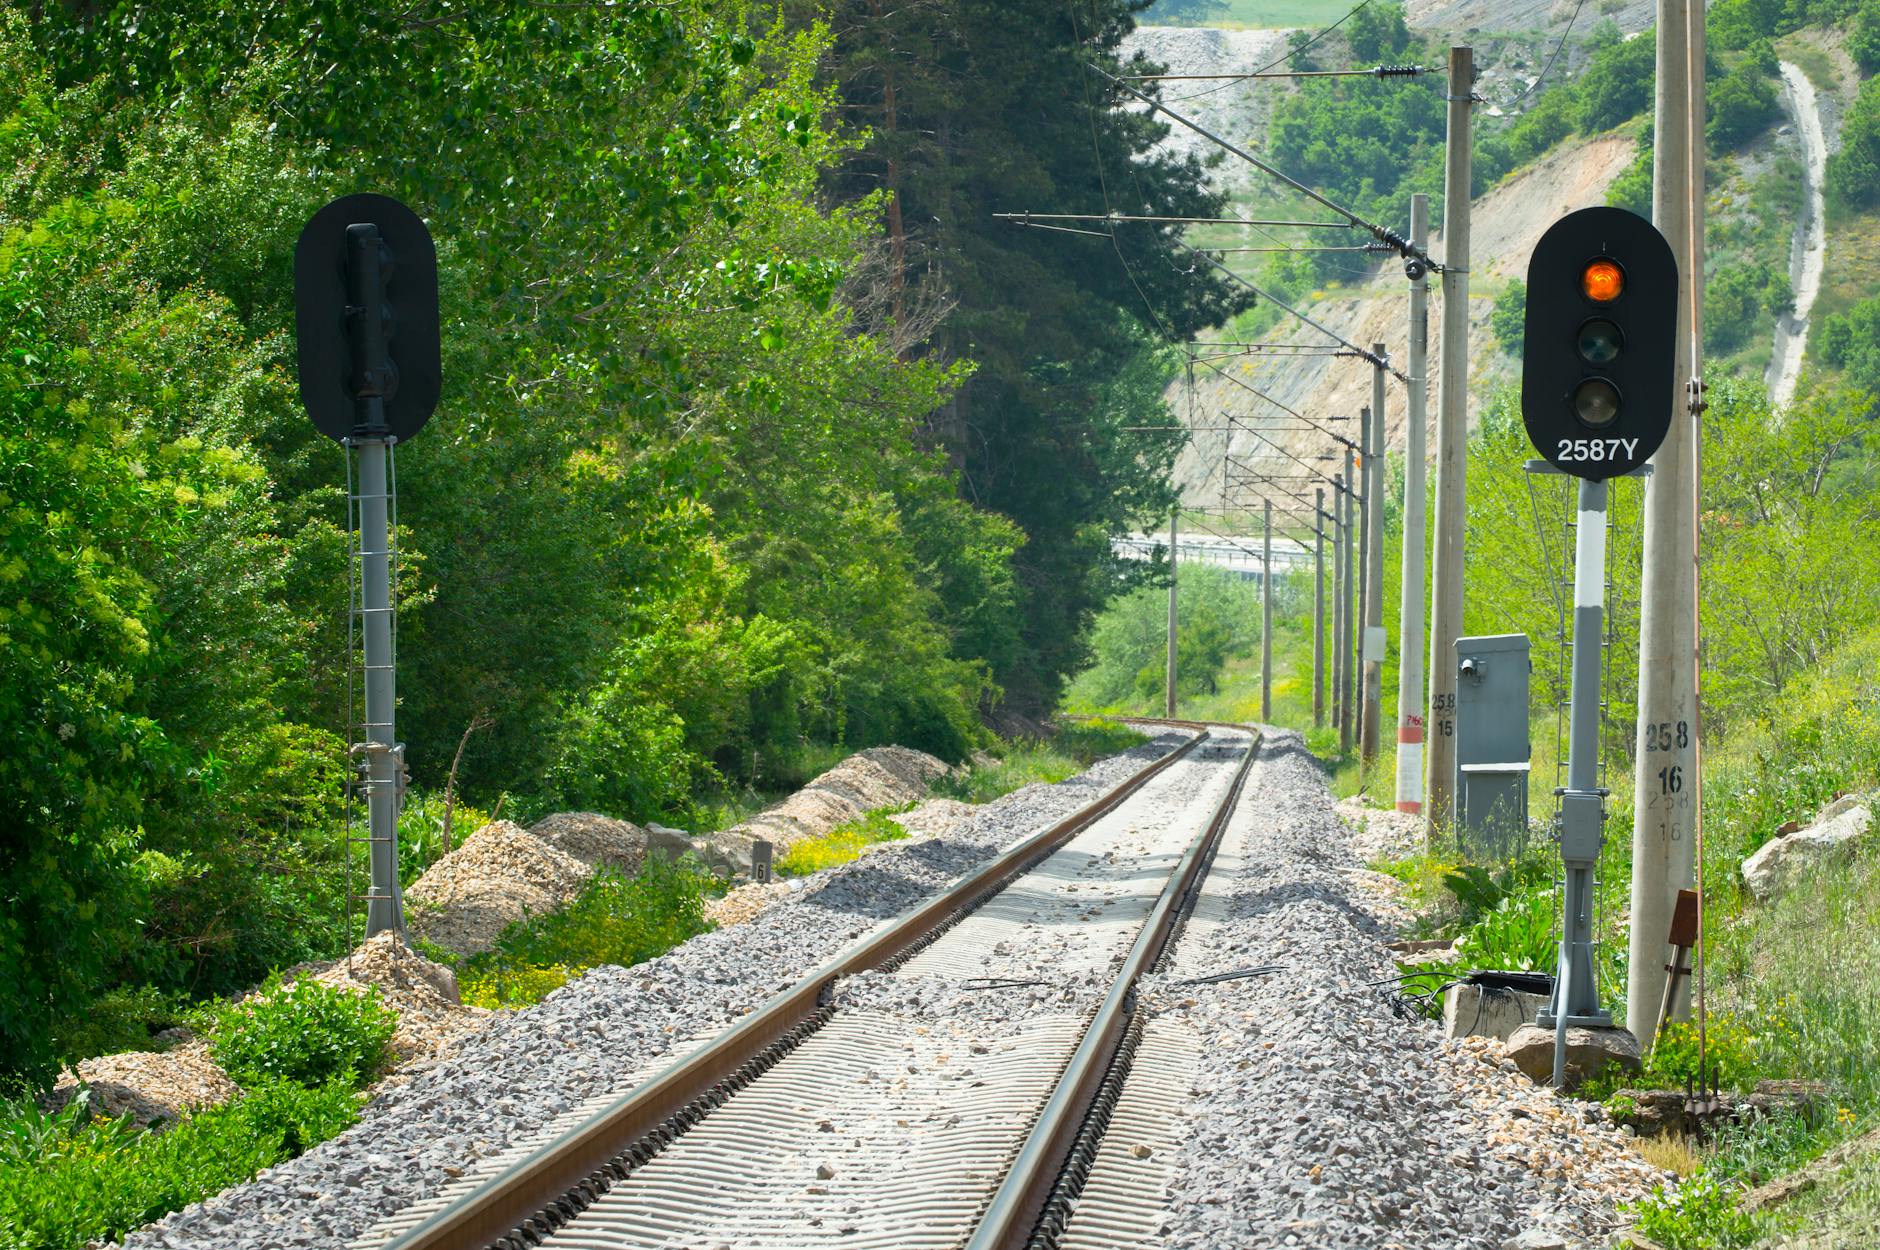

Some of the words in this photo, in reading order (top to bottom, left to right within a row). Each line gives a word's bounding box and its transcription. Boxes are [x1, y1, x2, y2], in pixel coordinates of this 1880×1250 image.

[1557, 438, 1639, 461] 2587Y
[1438, 720, 1452, 736] 15
[1658, 765, 1682, 795] 16
[1660, 823, 1680, 841] 16
[757, 863, 764, 879] 6
